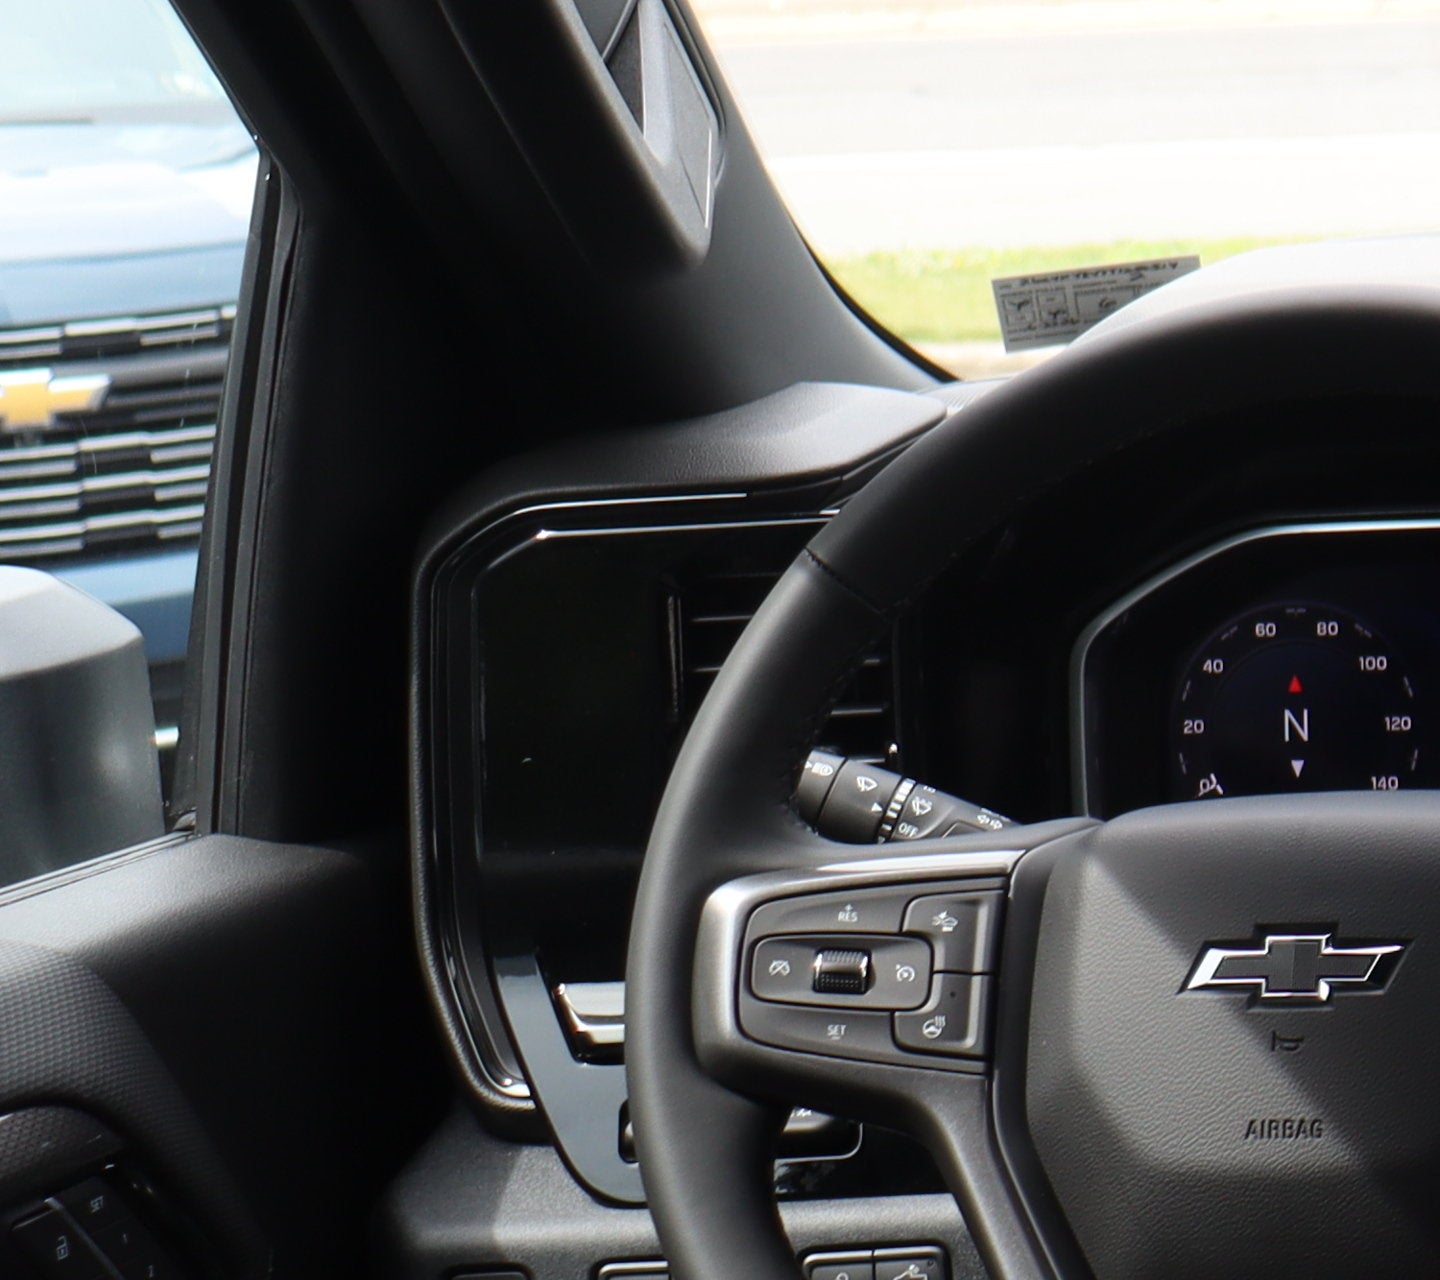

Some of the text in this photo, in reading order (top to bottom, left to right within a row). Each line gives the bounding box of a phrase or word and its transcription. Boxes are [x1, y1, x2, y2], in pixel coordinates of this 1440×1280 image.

[1255, 621, 1339, 637] 60 80
[1202, 655, 1387, 674] 40 100
[1183, 719, 1205, 734] 20
[1284, 708, 1309, 743] N
[1384, 716, 1412, 731] 120
[1371, 776, 1399, 790] 140
[898, 822, 920, 838] OFF
[837, 911, 858, 923] RES
[827, 1024, 847, 1036] SET
[1244, 1119, 1323, 1140] AIRBAG
